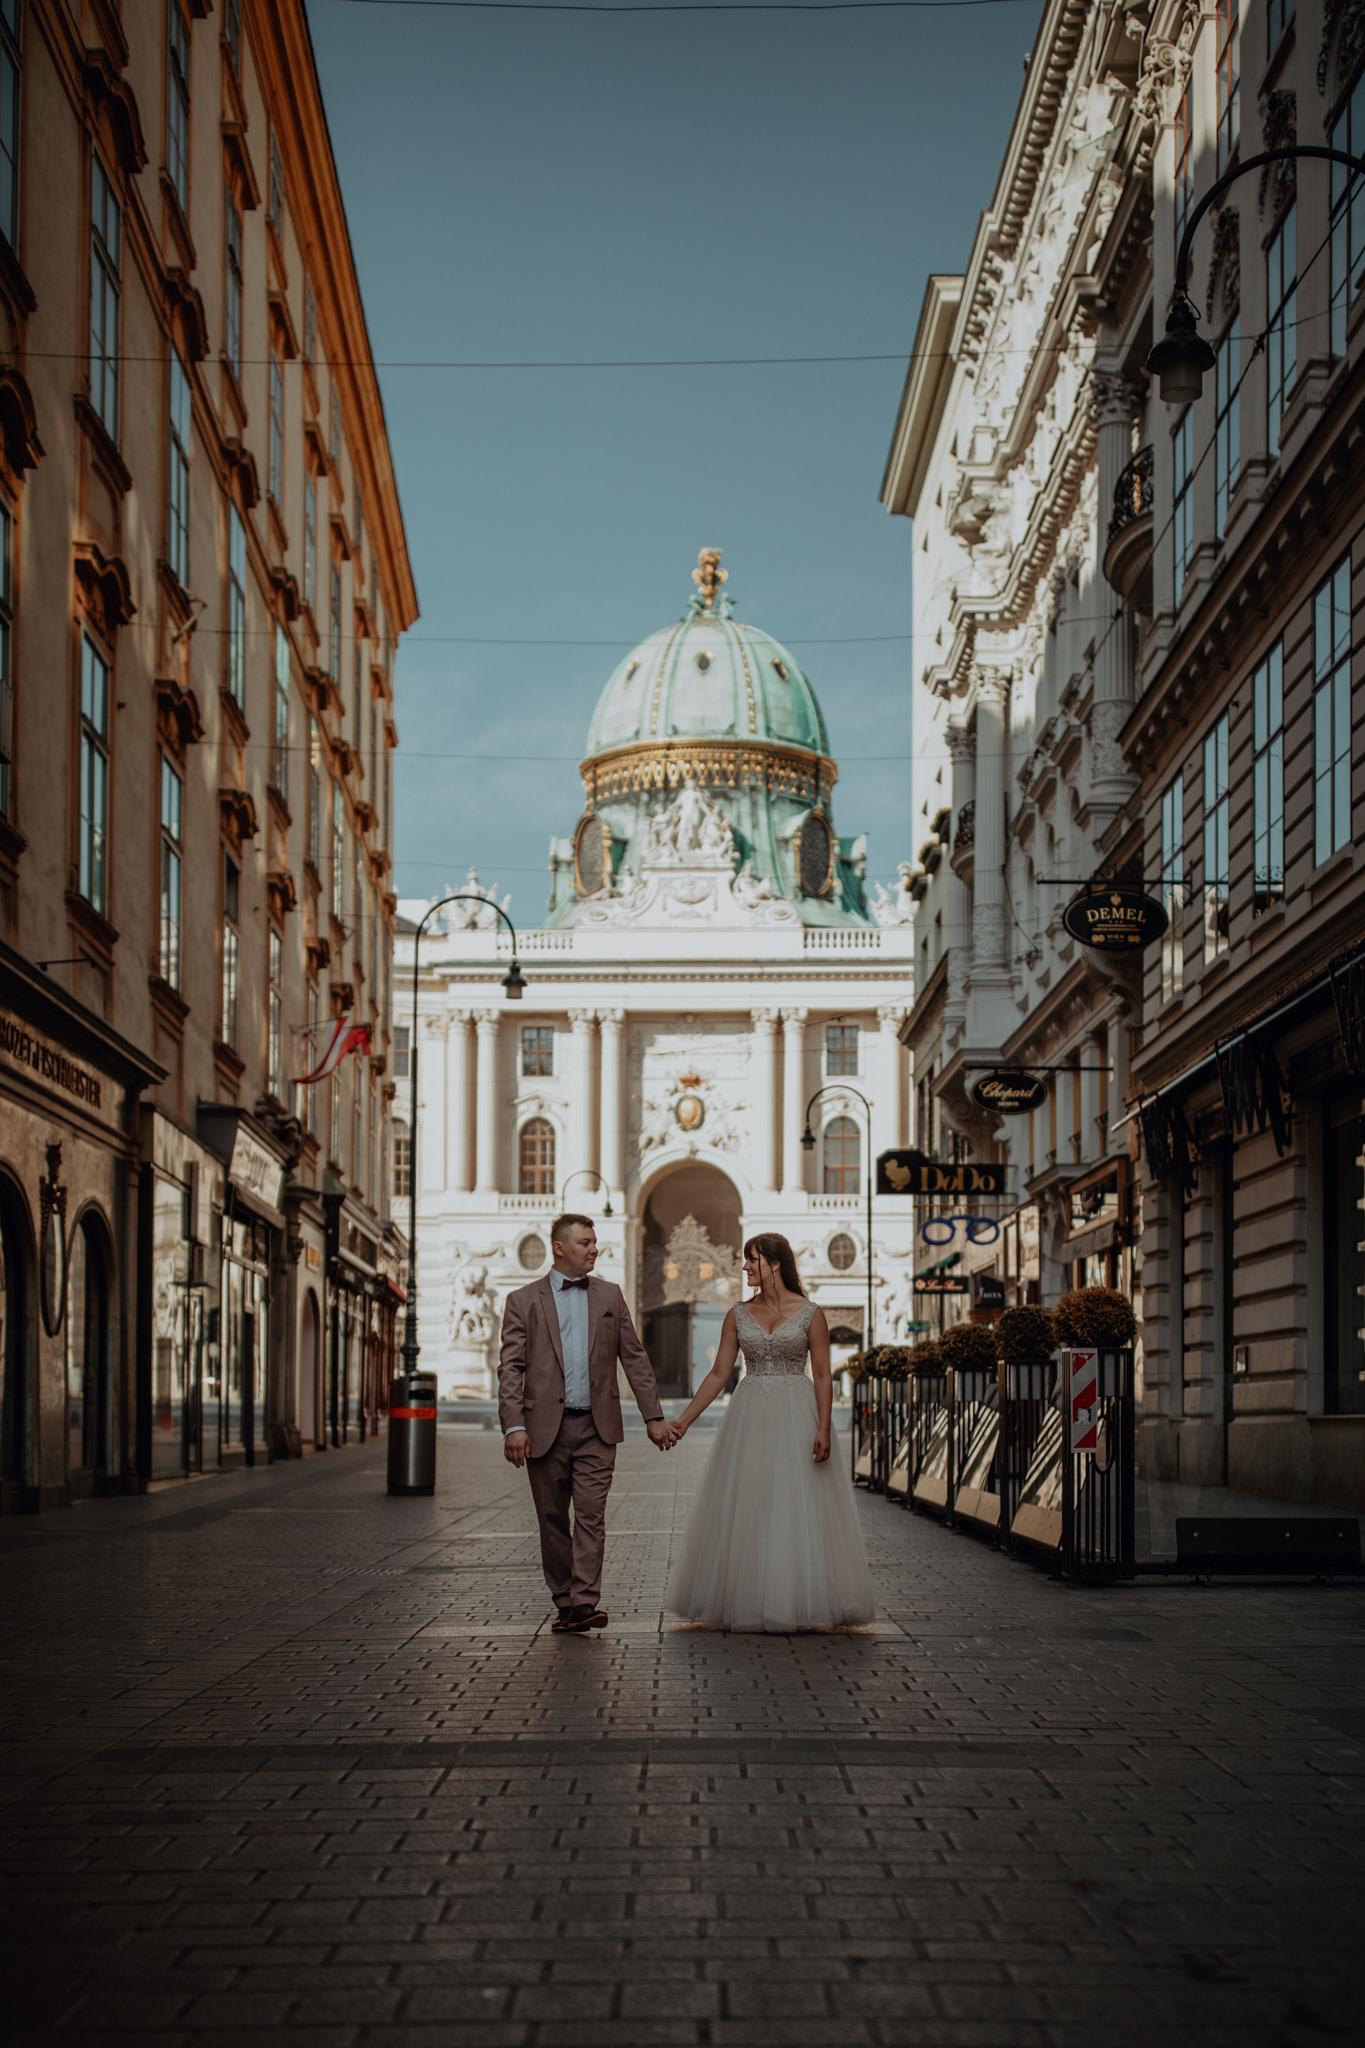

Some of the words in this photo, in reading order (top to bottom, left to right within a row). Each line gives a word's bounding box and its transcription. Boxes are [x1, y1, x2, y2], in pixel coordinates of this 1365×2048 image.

[1086, 907, 1146, 923] DEMEL
[978, 1081, 1039, 1101] Chopard
[919, 1166, 996, 1192] DoDo
